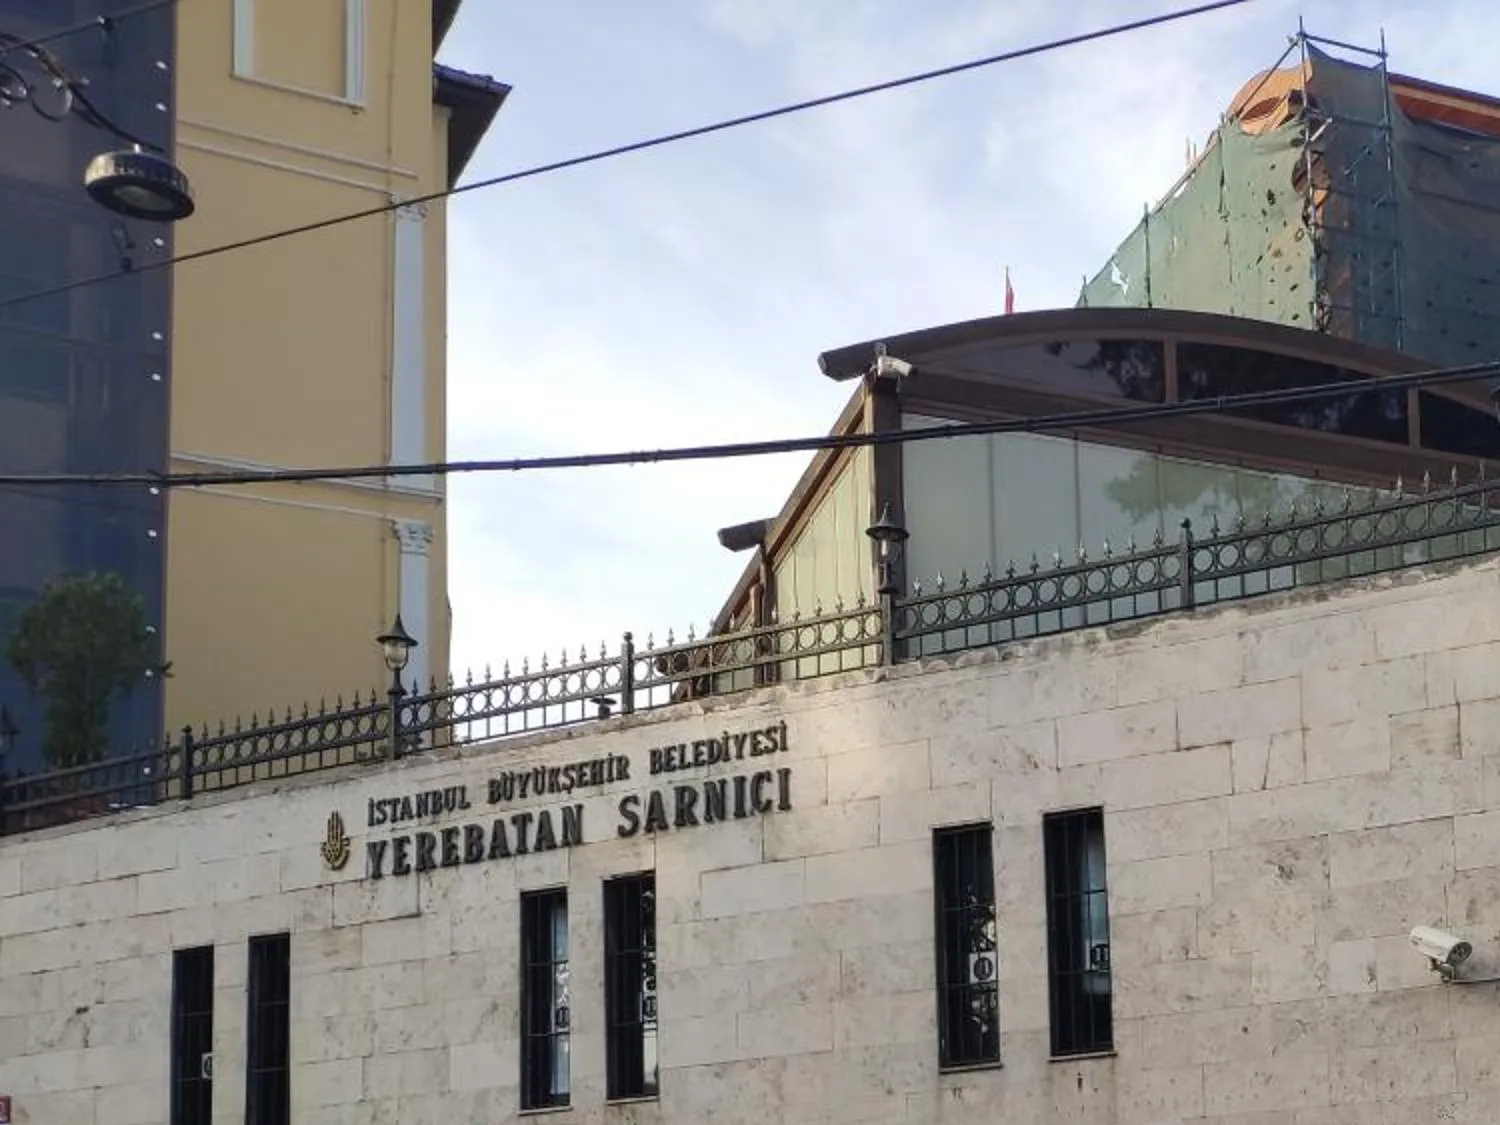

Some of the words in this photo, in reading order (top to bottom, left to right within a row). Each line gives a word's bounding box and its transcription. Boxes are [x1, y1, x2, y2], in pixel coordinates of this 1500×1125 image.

[365, 803, 584, 880] YEREBATAN
[616, 767, 793, 838] SARNICI
[367, 784, 471, 827] İSTANBUL
[487, 752, 630, 804] BÜYÜKŞEHİR
[649, 719, 788, 775] BELEDİYESİ
